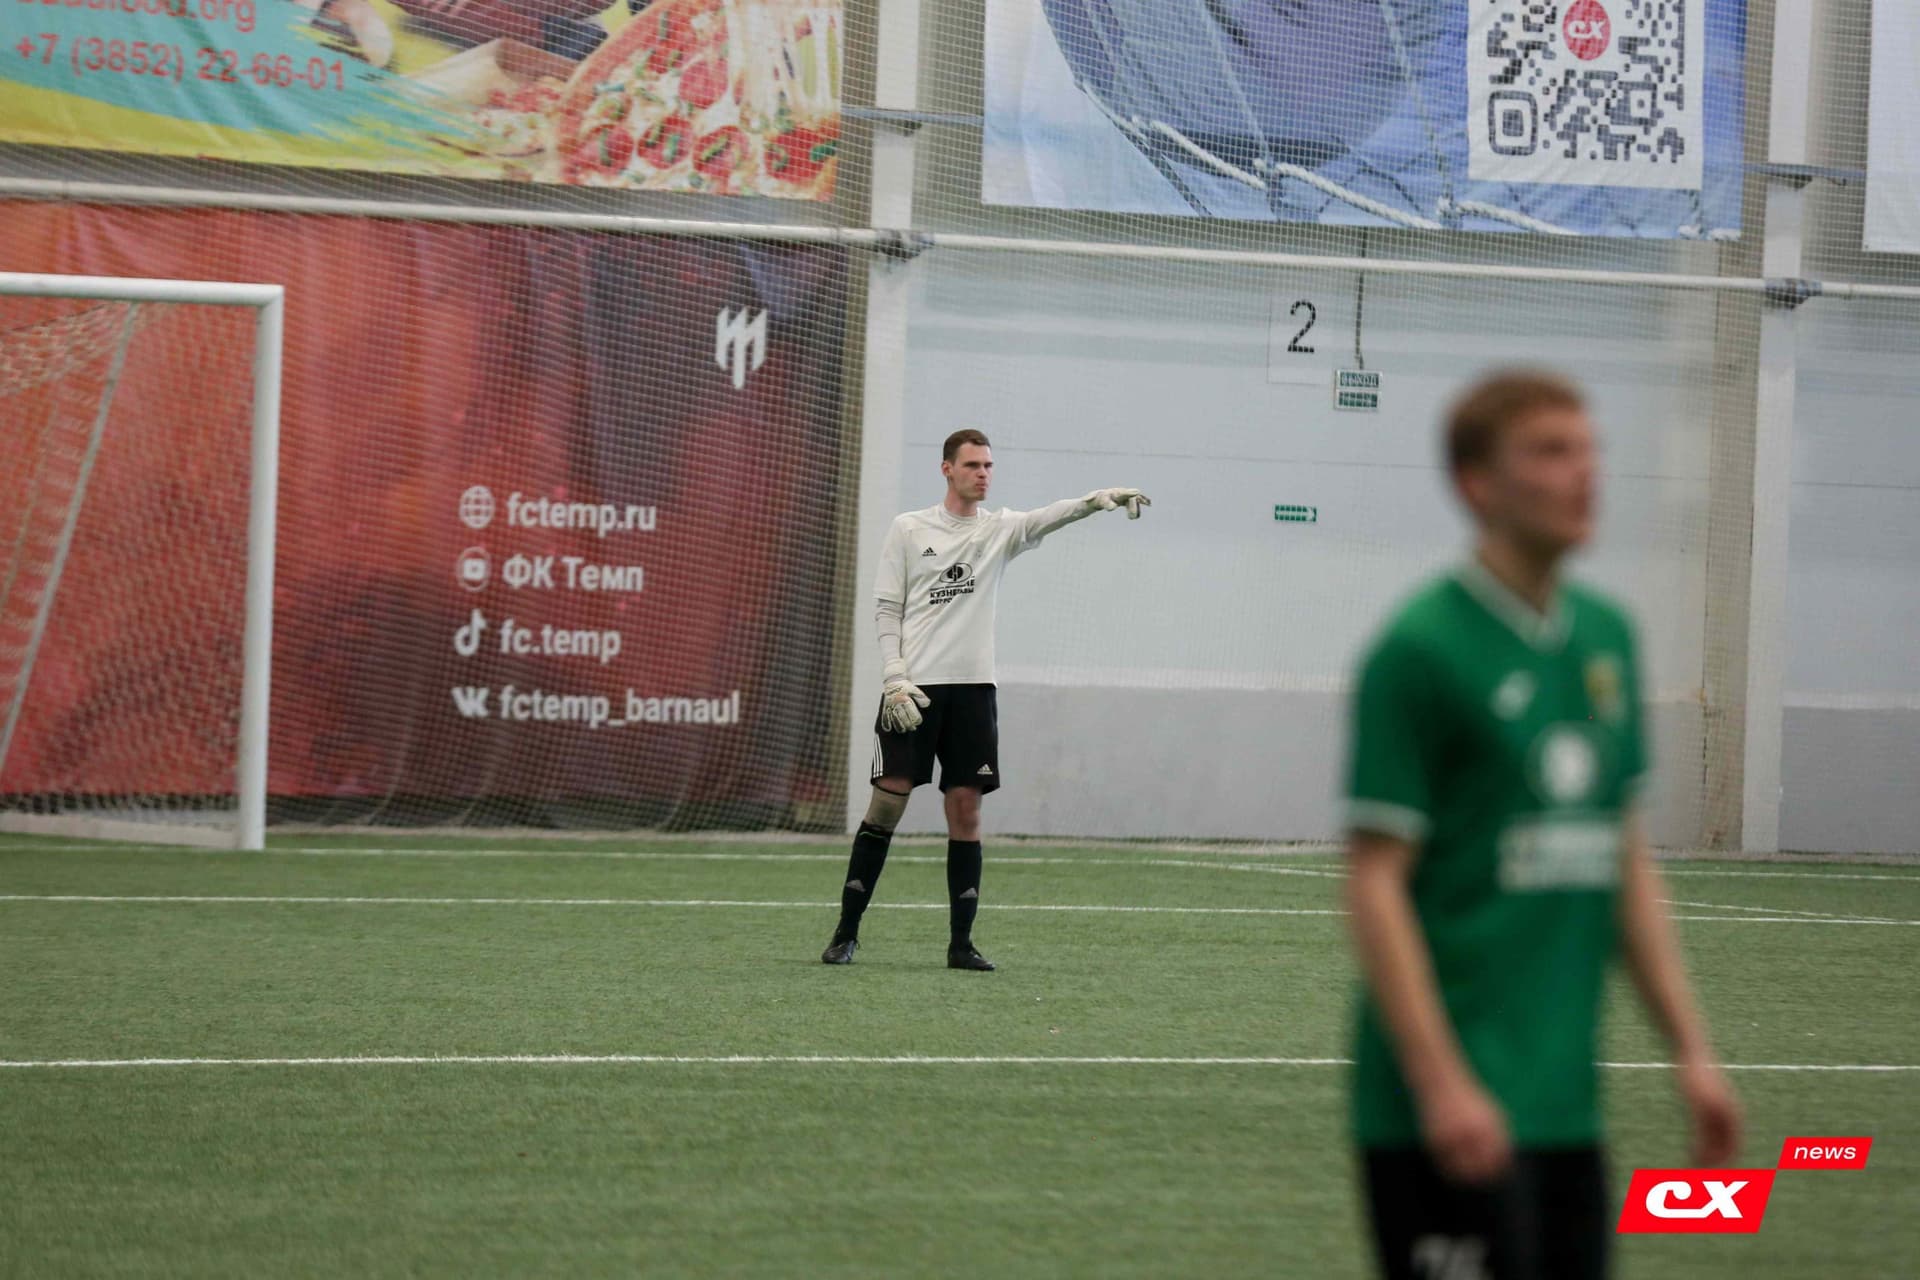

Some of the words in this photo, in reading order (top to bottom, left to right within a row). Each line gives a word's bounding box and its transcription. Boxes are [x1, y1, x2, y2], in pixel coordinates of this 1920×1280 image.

[16, 33, 59, 65] +7
[71, 37, 184, 84] (3852)
[196, 47, 345, 92] 22-66-01
[1288, 302, 1315, 354] 2
[507, 492, 656, 538] fctemp.ru
[502, 554, 555, 590] ФК
[562, 556, 643, 592] Темп
[499, 619, 621, 665] fc.temp
[499, 686, 741, 729] fctemp_barnaul
